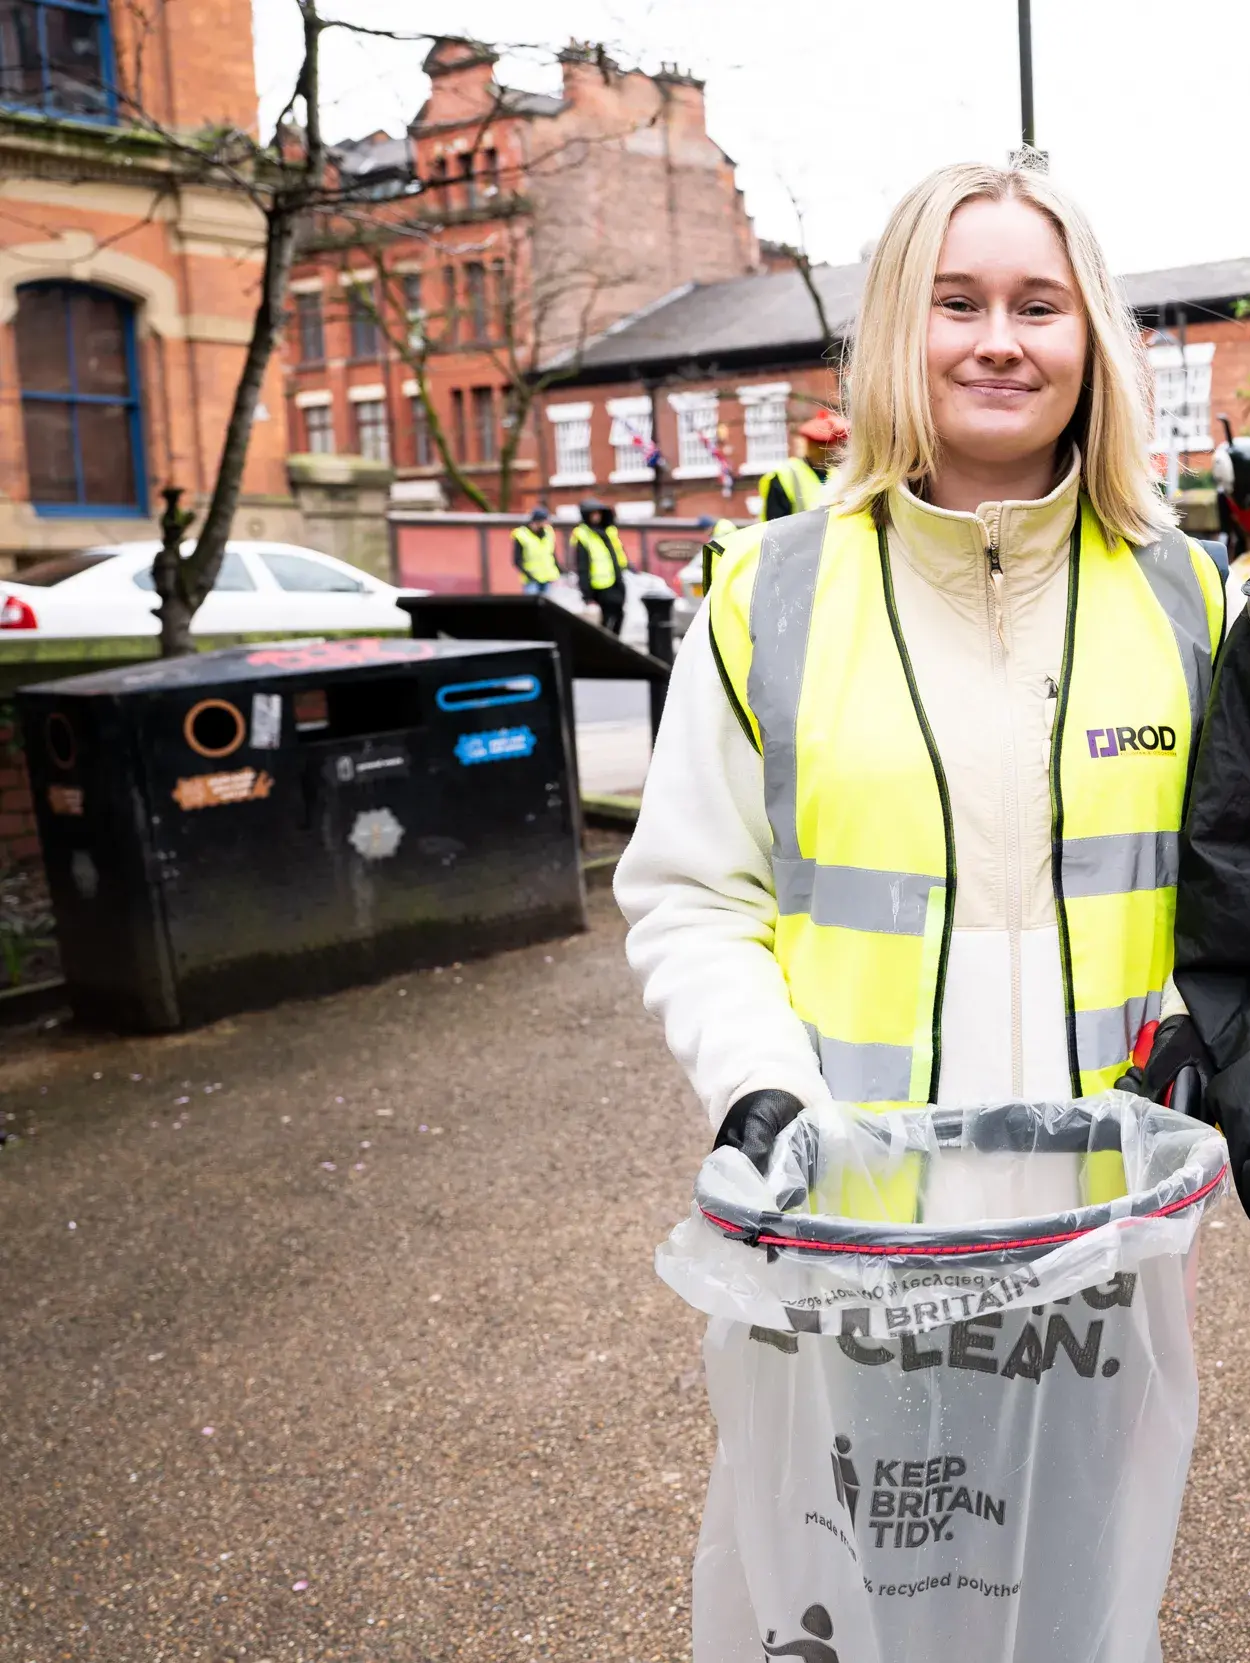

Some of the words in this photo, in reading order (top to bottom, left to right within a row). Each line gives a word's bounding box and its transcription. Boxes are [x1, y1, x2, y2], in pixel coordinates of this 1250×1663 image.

[1116, 726, 1176, 751] ROD
[886, 1263, 1041, 1330] BRITAIN
[874, 1455, 967, 1488] KEEP
[869, 1484, 1006, 1526] BRITAIN
[805, 1511, 838, 1538] Made
[868, 1514, 954, 1549] TIDY.
[878, 1572, 952, 1598] recycled
[957, 1575, 1022, 1598] polythe
